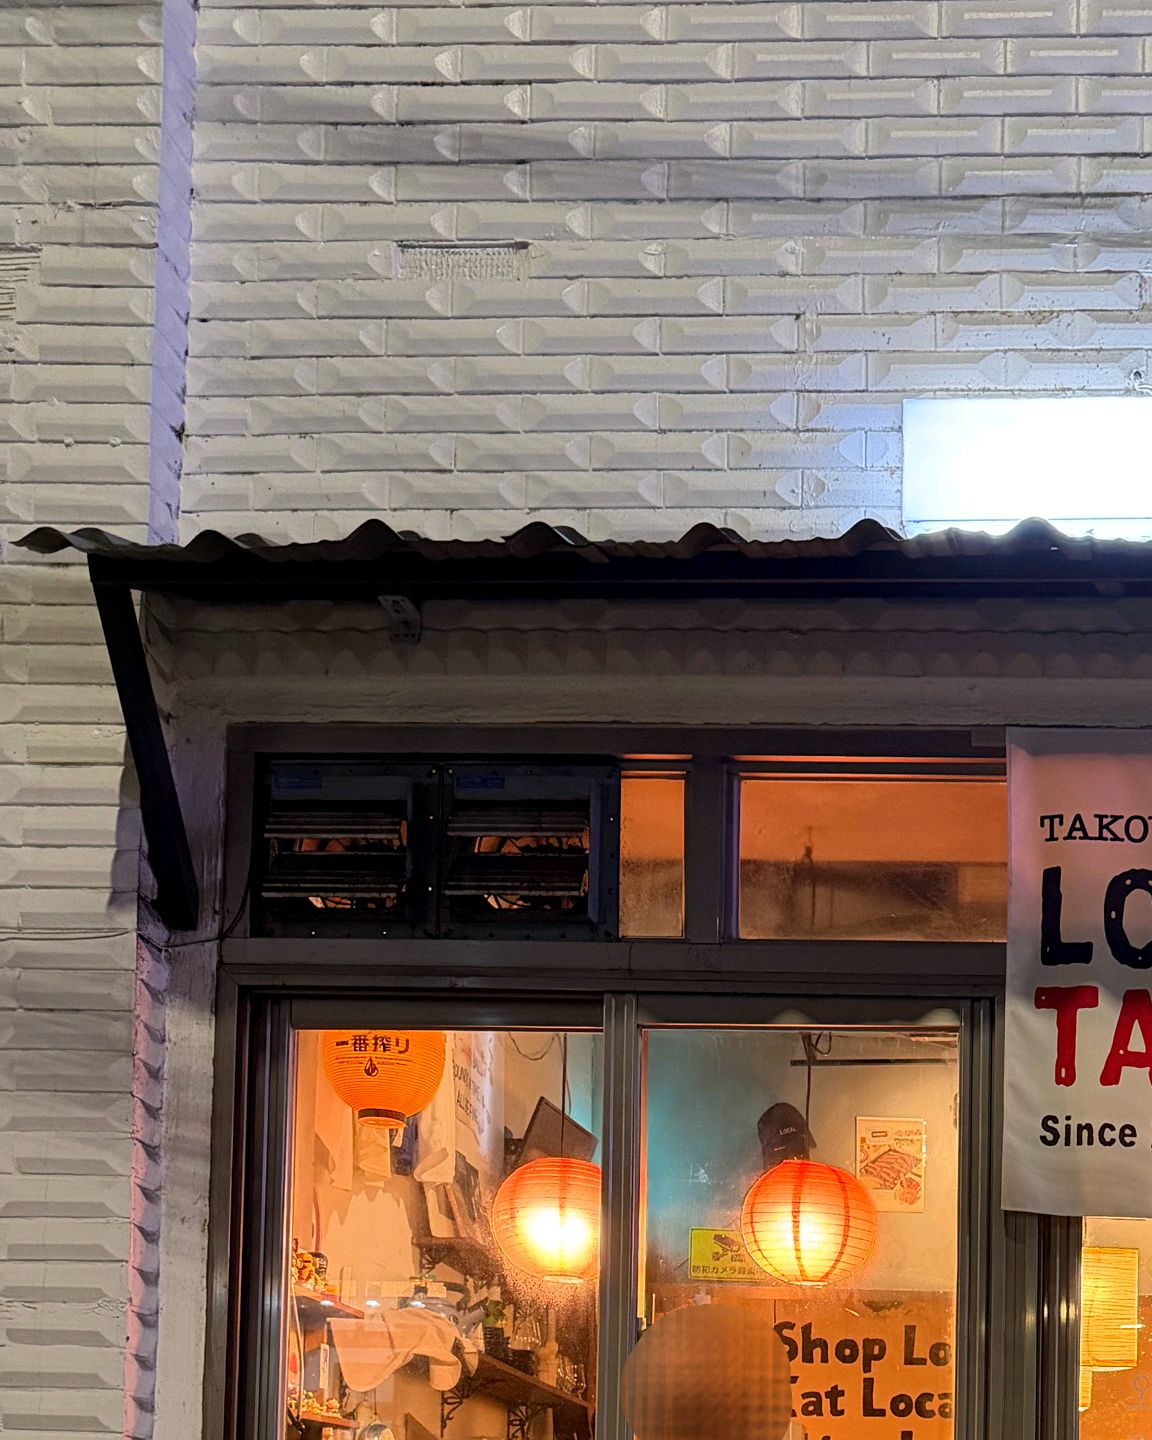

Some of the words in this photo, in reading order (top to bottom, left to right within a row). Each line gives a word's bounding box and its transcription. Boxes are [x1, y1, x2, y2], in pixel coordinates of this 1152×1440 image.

[336, 1034, 410, 1054] 一番搾り
[1039, 1115, 1137, 1148] Since
[773, 1321, 887, 1374] Shop
[790, 1375, 845, 1418] at
